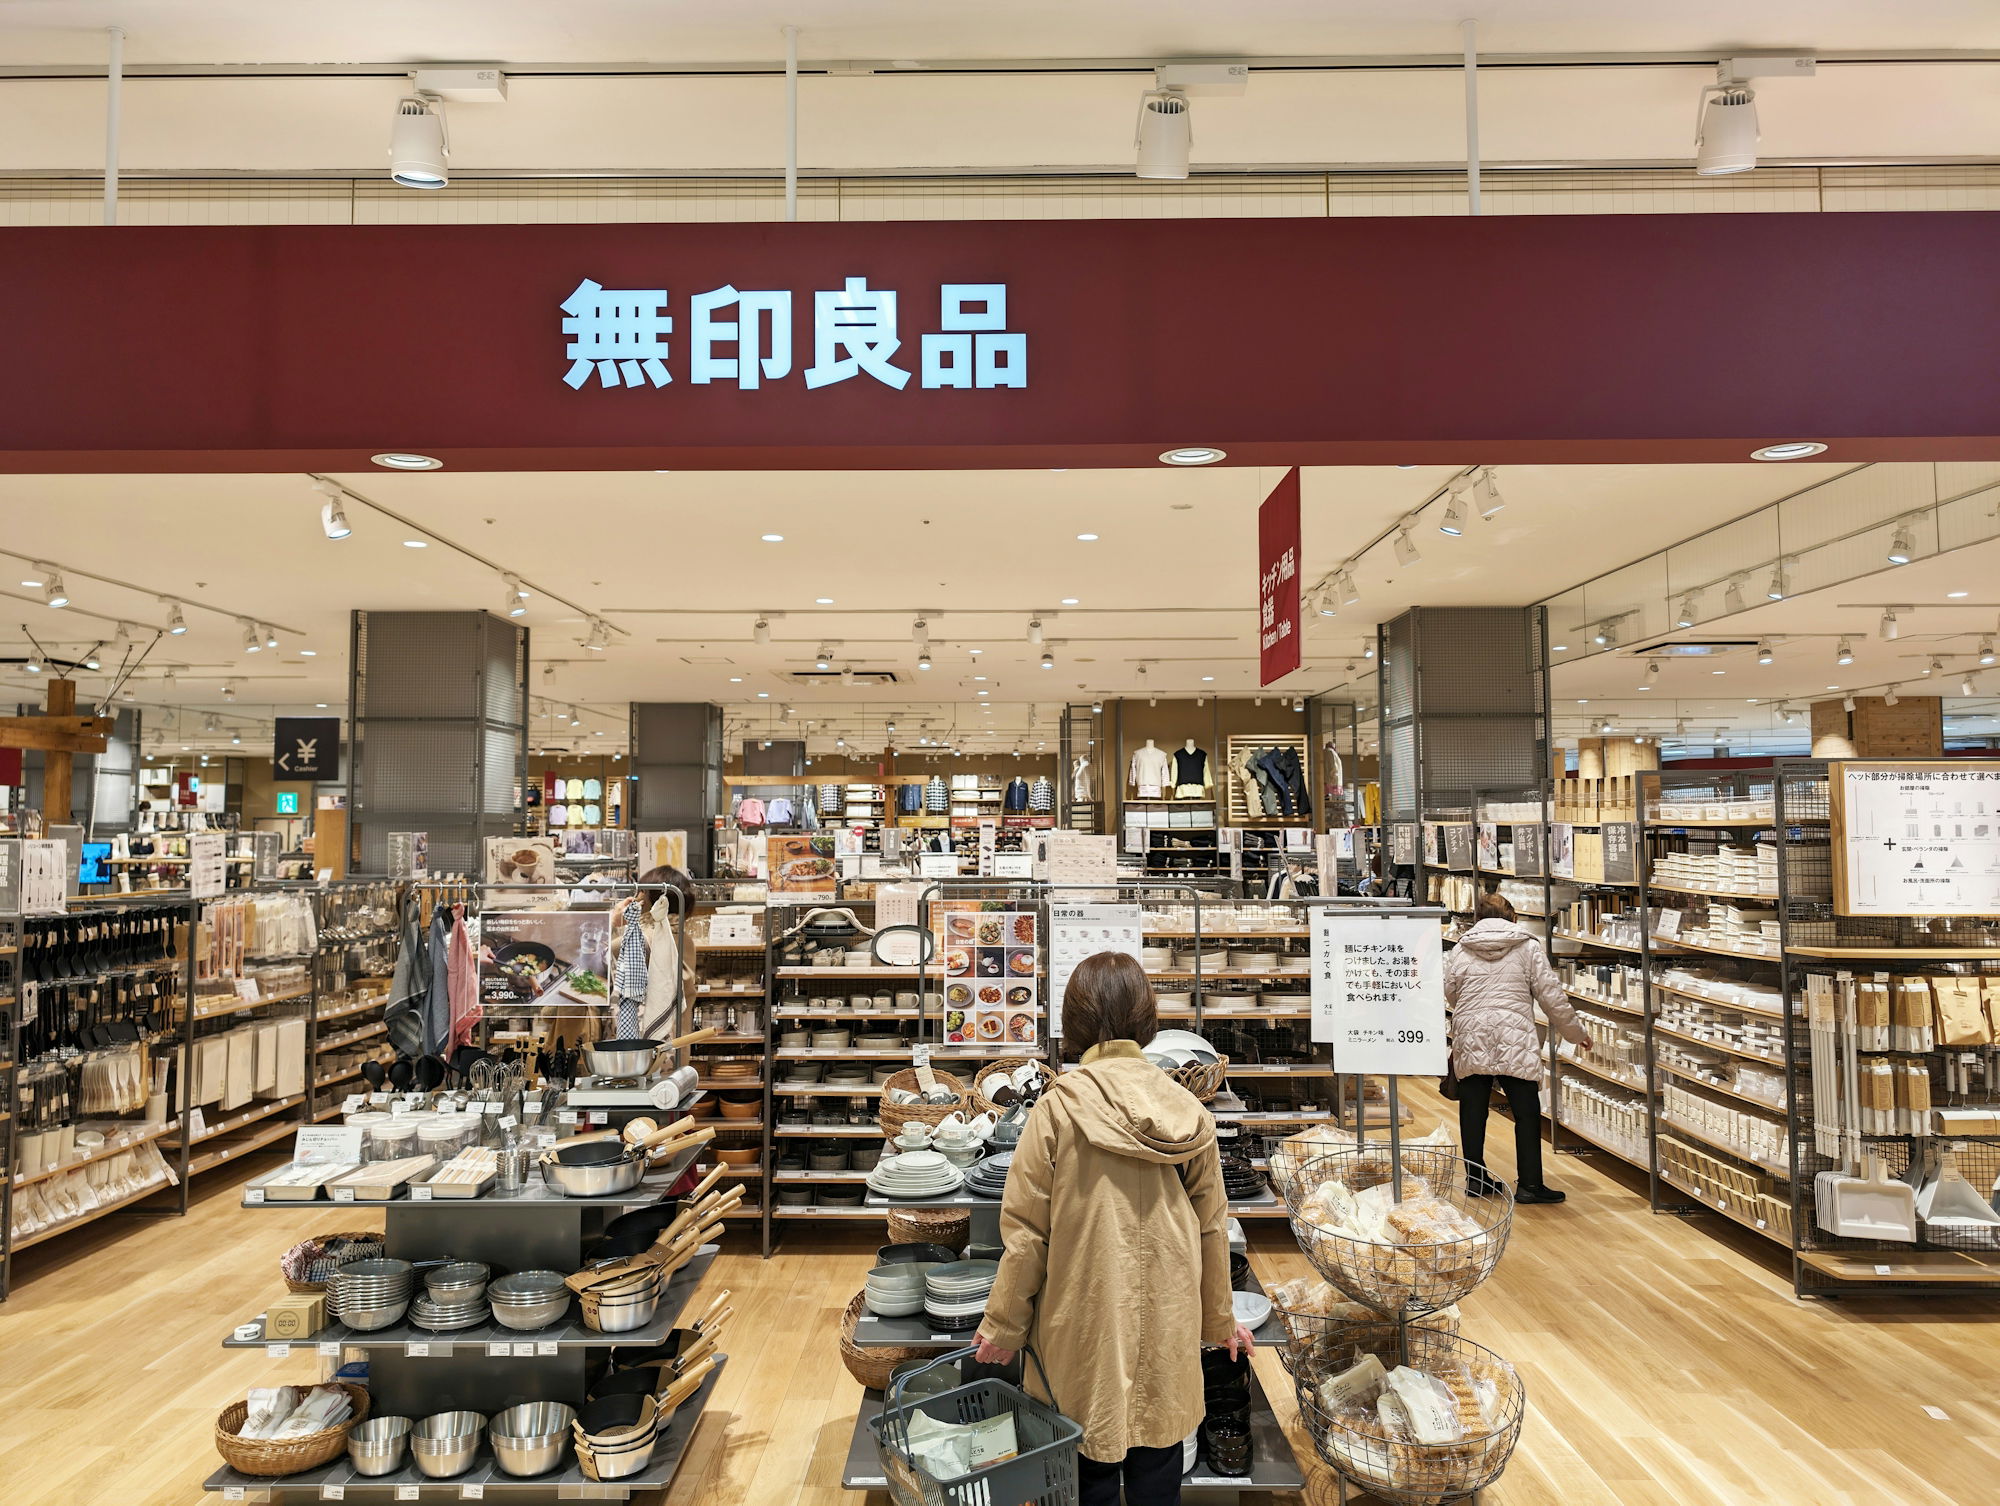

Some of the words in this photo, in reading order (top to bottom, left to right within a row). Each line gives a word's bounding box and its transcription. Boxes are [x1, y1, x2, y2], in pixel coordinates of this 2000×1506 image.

[560, 277, 1027, 390] 無印良品
[1262, 546, 1294, 598] キッチン用品
[1262, 595, 1275, 630] 食器
[1262, 629, 1278, 651] Kitchen
[1278, 617, 1292, 640] Table
[1449, 828, 1458, 854] コンテナ
[1456, 827, 1465, 848] フード
[1517, 827, 1527, 851] 弁当箱
[1525, 827, 1535, 863] マグボトル
[1607, 825, 1618, 862] 保存容器
[1616, 825, 1627, 852] 冷水筒
[1344, 944, 1405, 954] 麺にチキン味を
[1344, 956, 1418, 965] つけました。お湯を
[1345, 968, 1419, 977] かけても、そのまま
[491, 991, 514, 1000] 3,990
[1345, 980, 1422, 990] でも手軽においしく
[1346, 993, 1402, 1002] 食べられます。
[1397, 1030, 1424, 1043] 399
